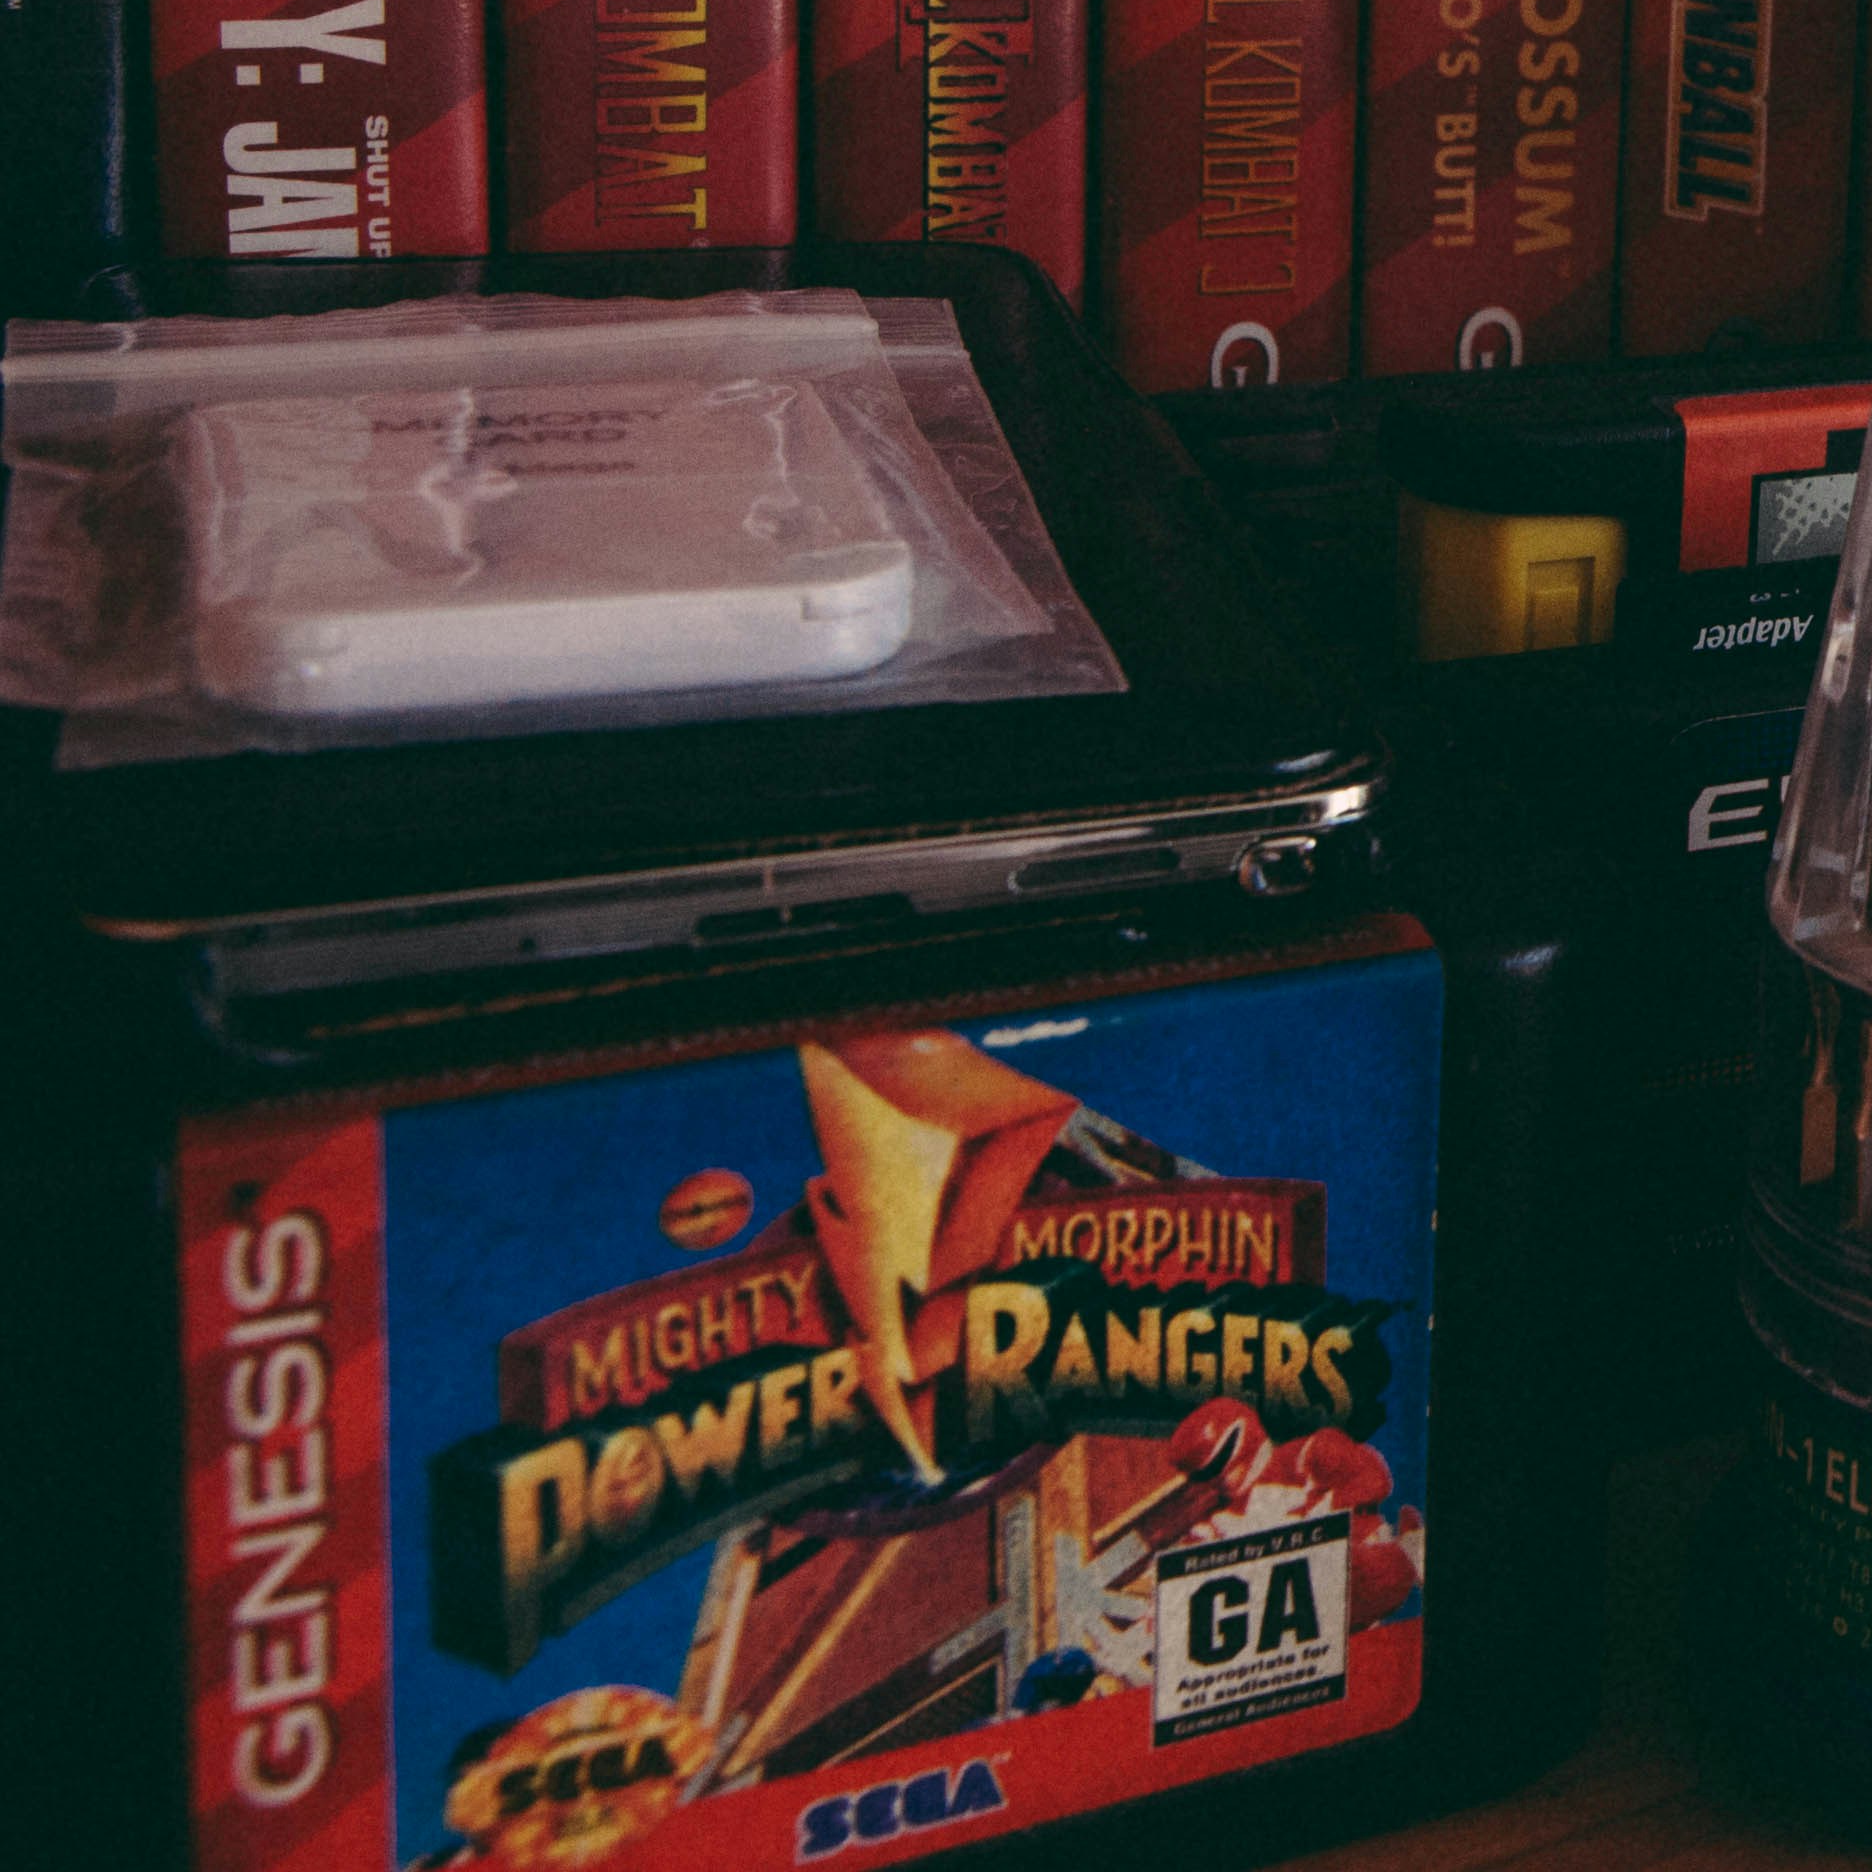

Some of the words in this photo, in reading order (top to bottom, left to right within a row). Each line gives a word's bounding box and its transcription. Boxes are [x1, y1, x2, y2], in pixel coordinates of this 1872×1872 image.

[366, 114, 391, 207] SHUT
[1198, 37, 1304, 245] KOMBAT
[1430, 110, 1478, 249] BUTT!
[1692, 614, 1814, 651] Adapter
[1012, 1207, 1276, 1274] MORPHIN
[570, 1259, 817, 1415] MIGHTY
[964, 1280, 1357, 1442] RANGERS
[222, 1211, 332, 1811] GENESIS
[496, 1345, 864, 1673] POWER
[1184, 1547, 1240, 1573] Rated
[1189, 1558, 1320, 1666] GA
[1173, 1708, 1241, 1736] General
[1176, 1652, 1296, 1695] Appropriate
[1304, 1644, 1329, 1660] for
[797, 1758, 1008, 1866] SEGA
